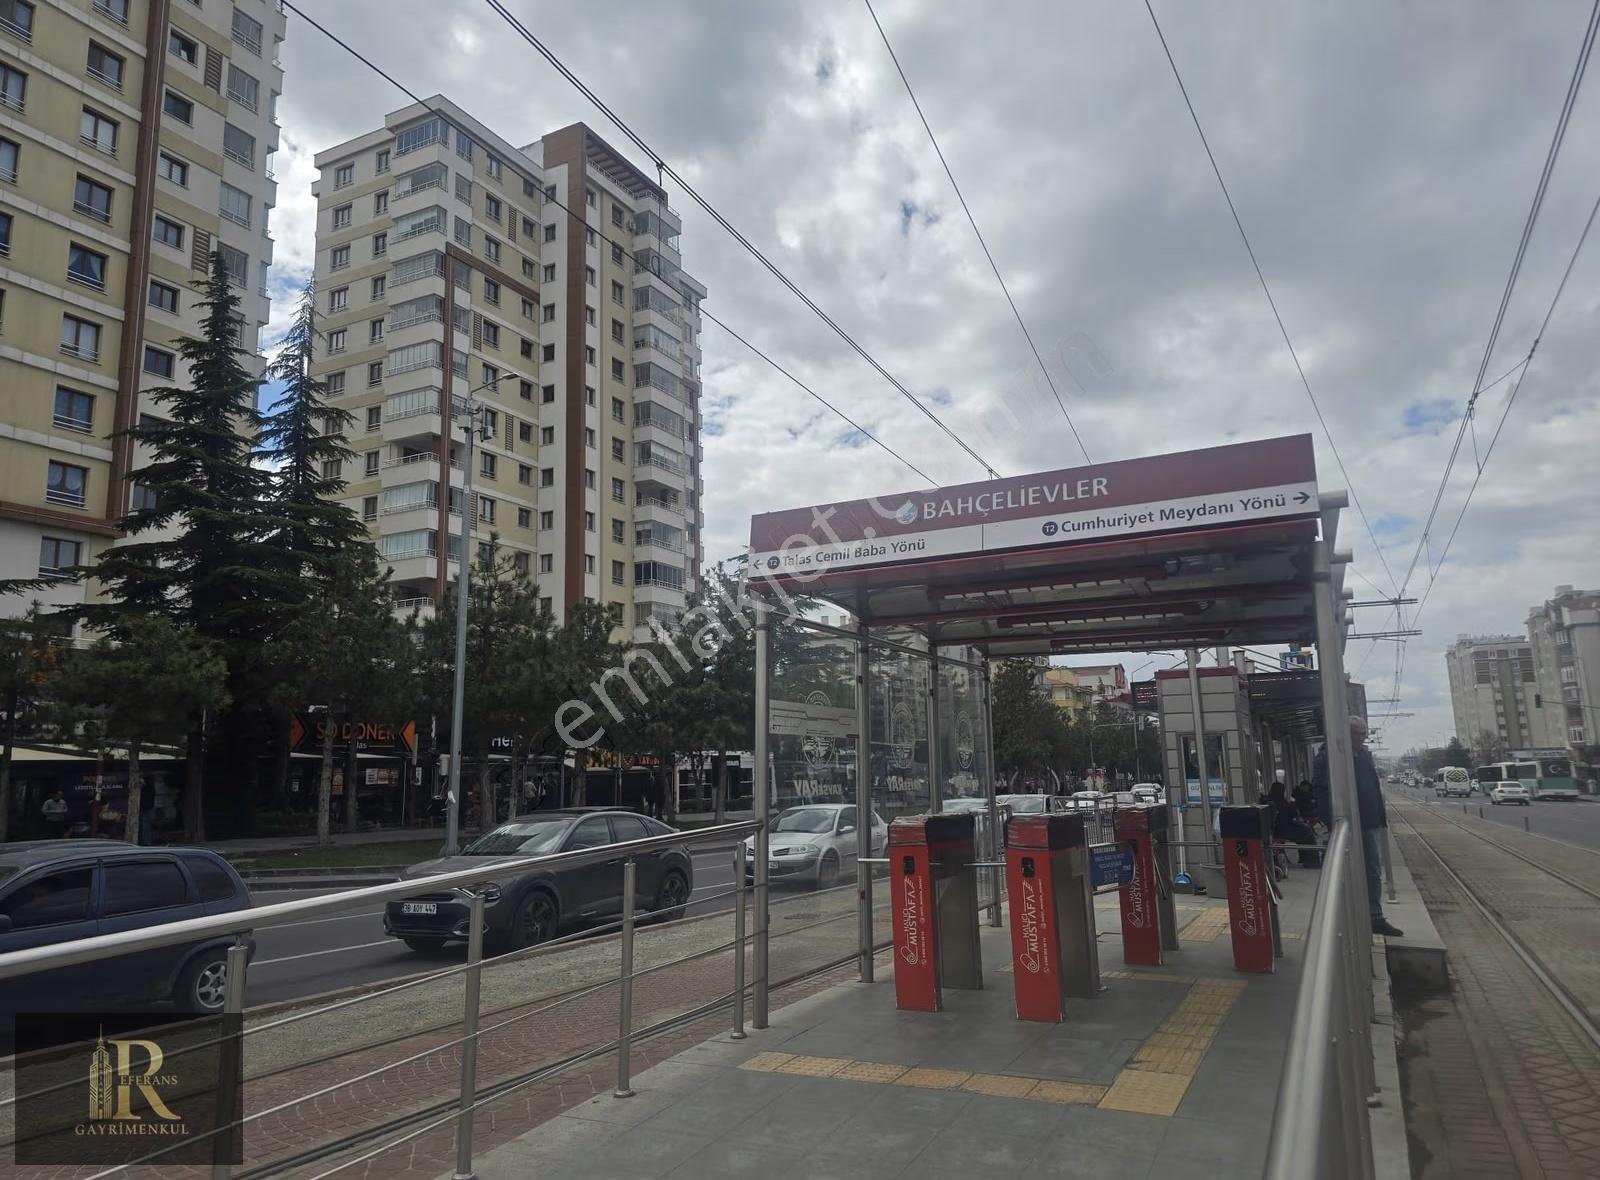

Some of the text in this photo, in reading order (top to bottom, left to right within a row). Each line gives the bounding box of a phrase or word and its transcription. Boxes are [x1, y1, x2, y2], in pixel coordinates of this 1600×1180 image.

[922, 477, 1109, 518] BAHÇELİEVLER
[1061, 511, 1154, 533] Cumhuriyet
[1160, 503, 1234, 522] Meydanı
[1239, 494, 1286, 511] Yönü
[782, 553, 812, 566] Talas
[815, 549, 850, 563] Cemil
[854, 544, 886, 558] Baba
[890, 538, 926, 553] Yönü
[907, 889, 919, 945] MUSTAFA
[1243, 871, 1257, 920] MUSTAFA
[1026, 894, 1040, 953] MUSTAFA
